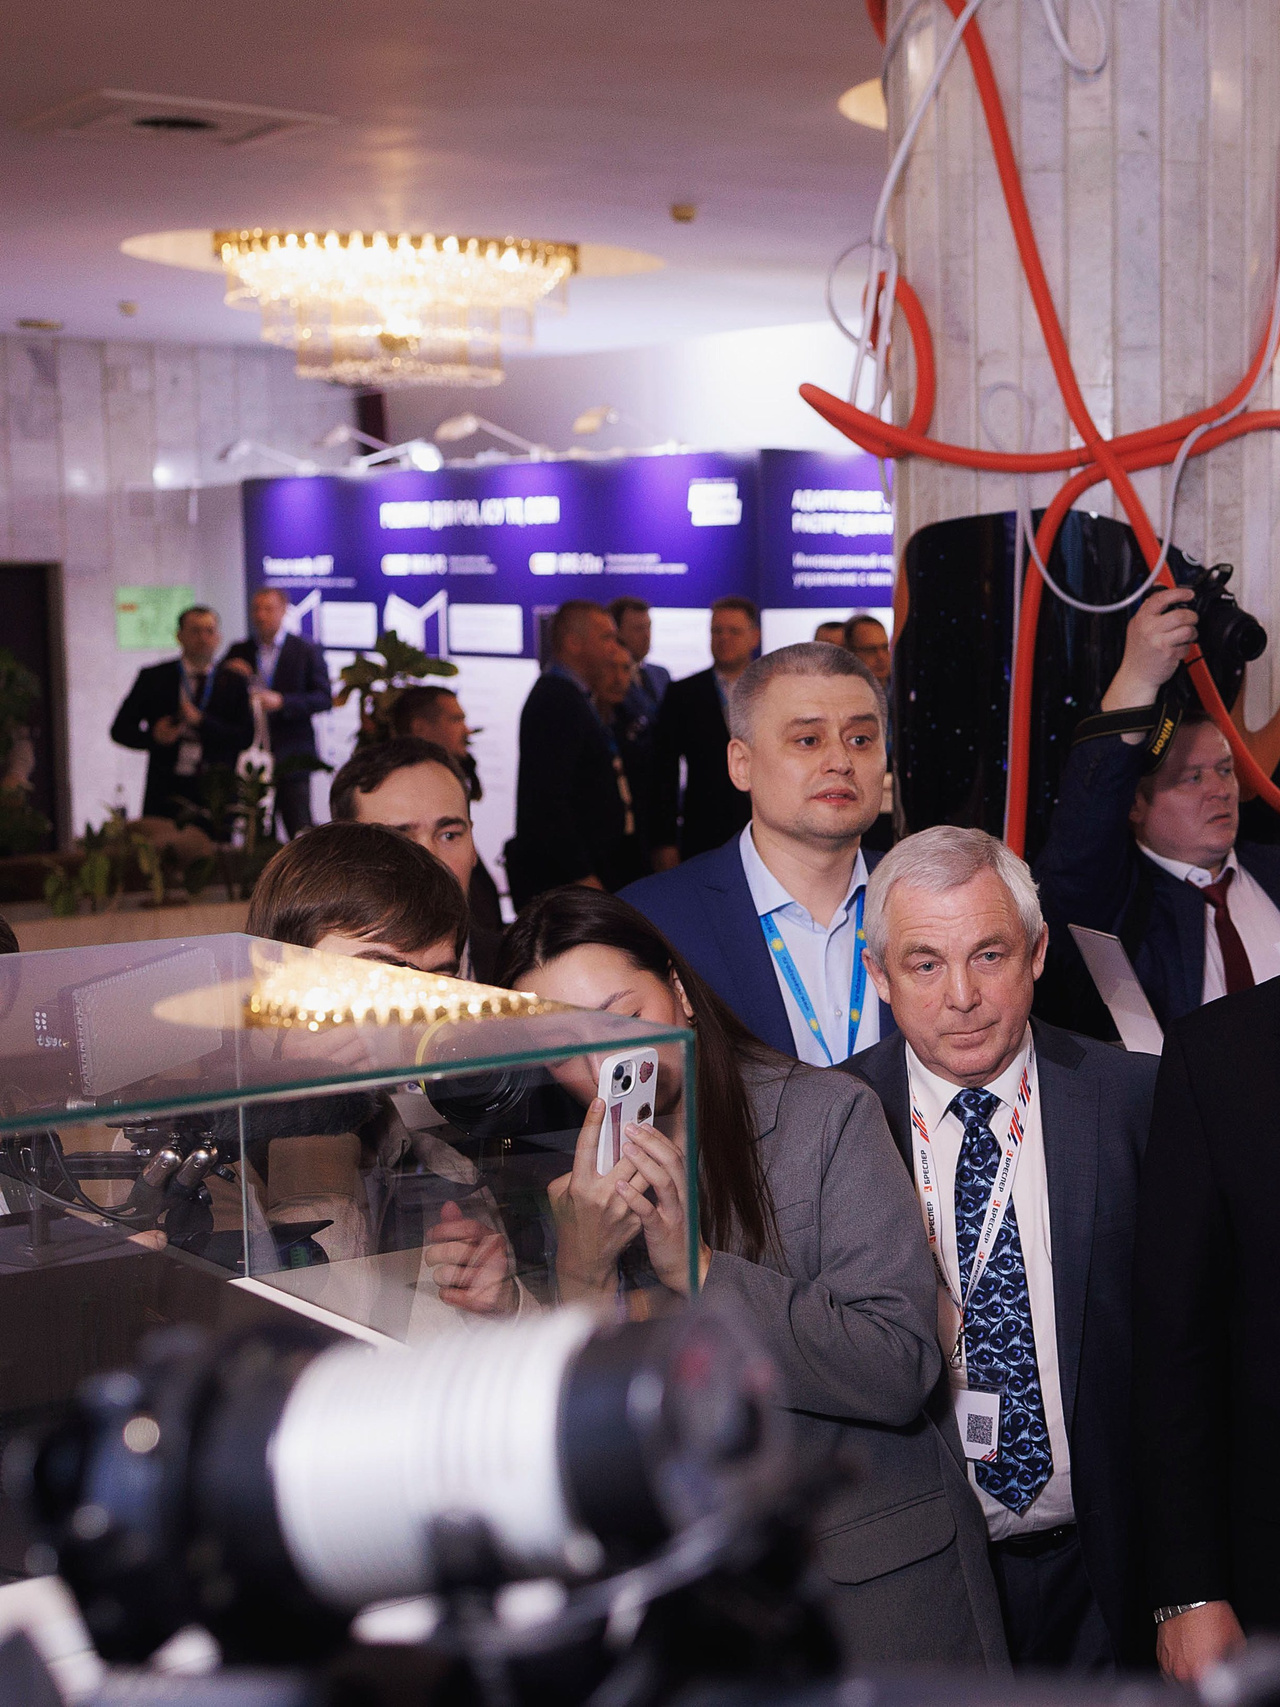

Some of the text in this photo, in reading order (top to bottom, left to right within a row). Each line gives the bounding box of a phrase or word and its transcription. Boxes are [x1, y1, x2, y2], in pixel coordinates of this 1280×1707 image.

[920, 1149, 931, 1185] БРЕСЛЕР
[999, 1157, 1012, 1193] БРЕСЛЕР
[926, 1201, 936, 1236] БРЕСЛЕР
[984, 1207, 999, 1244] БРЕСЛЕР
